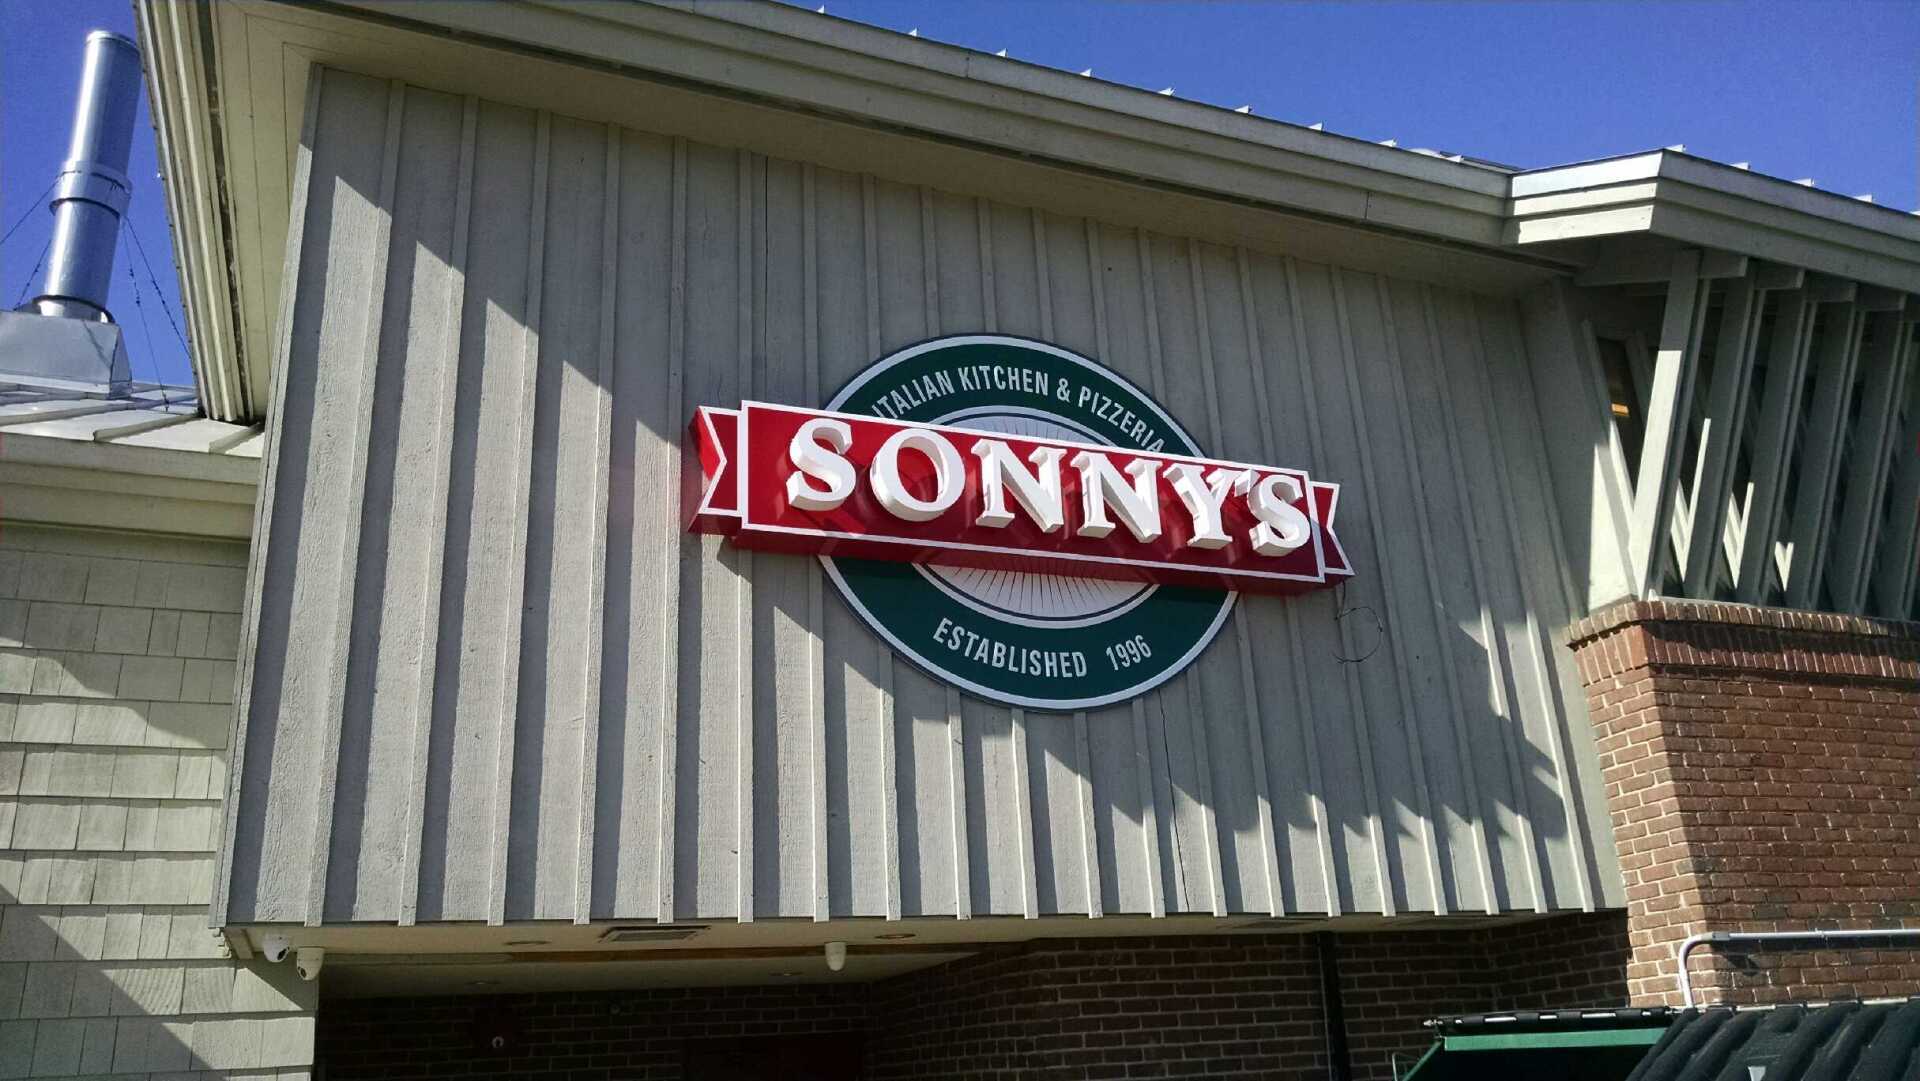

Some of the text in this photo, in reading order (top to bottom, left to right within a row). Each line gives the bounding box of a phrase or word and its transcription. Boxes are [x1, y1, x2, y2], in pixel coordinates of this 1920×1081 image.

[871, 365, 1165, 452] ITALIAN KITCHEN & PIZZERIA
[787, 419, 1311, 556] SONNY'S
[933, 618, 1152, 678] ESTABLISHED 1996
